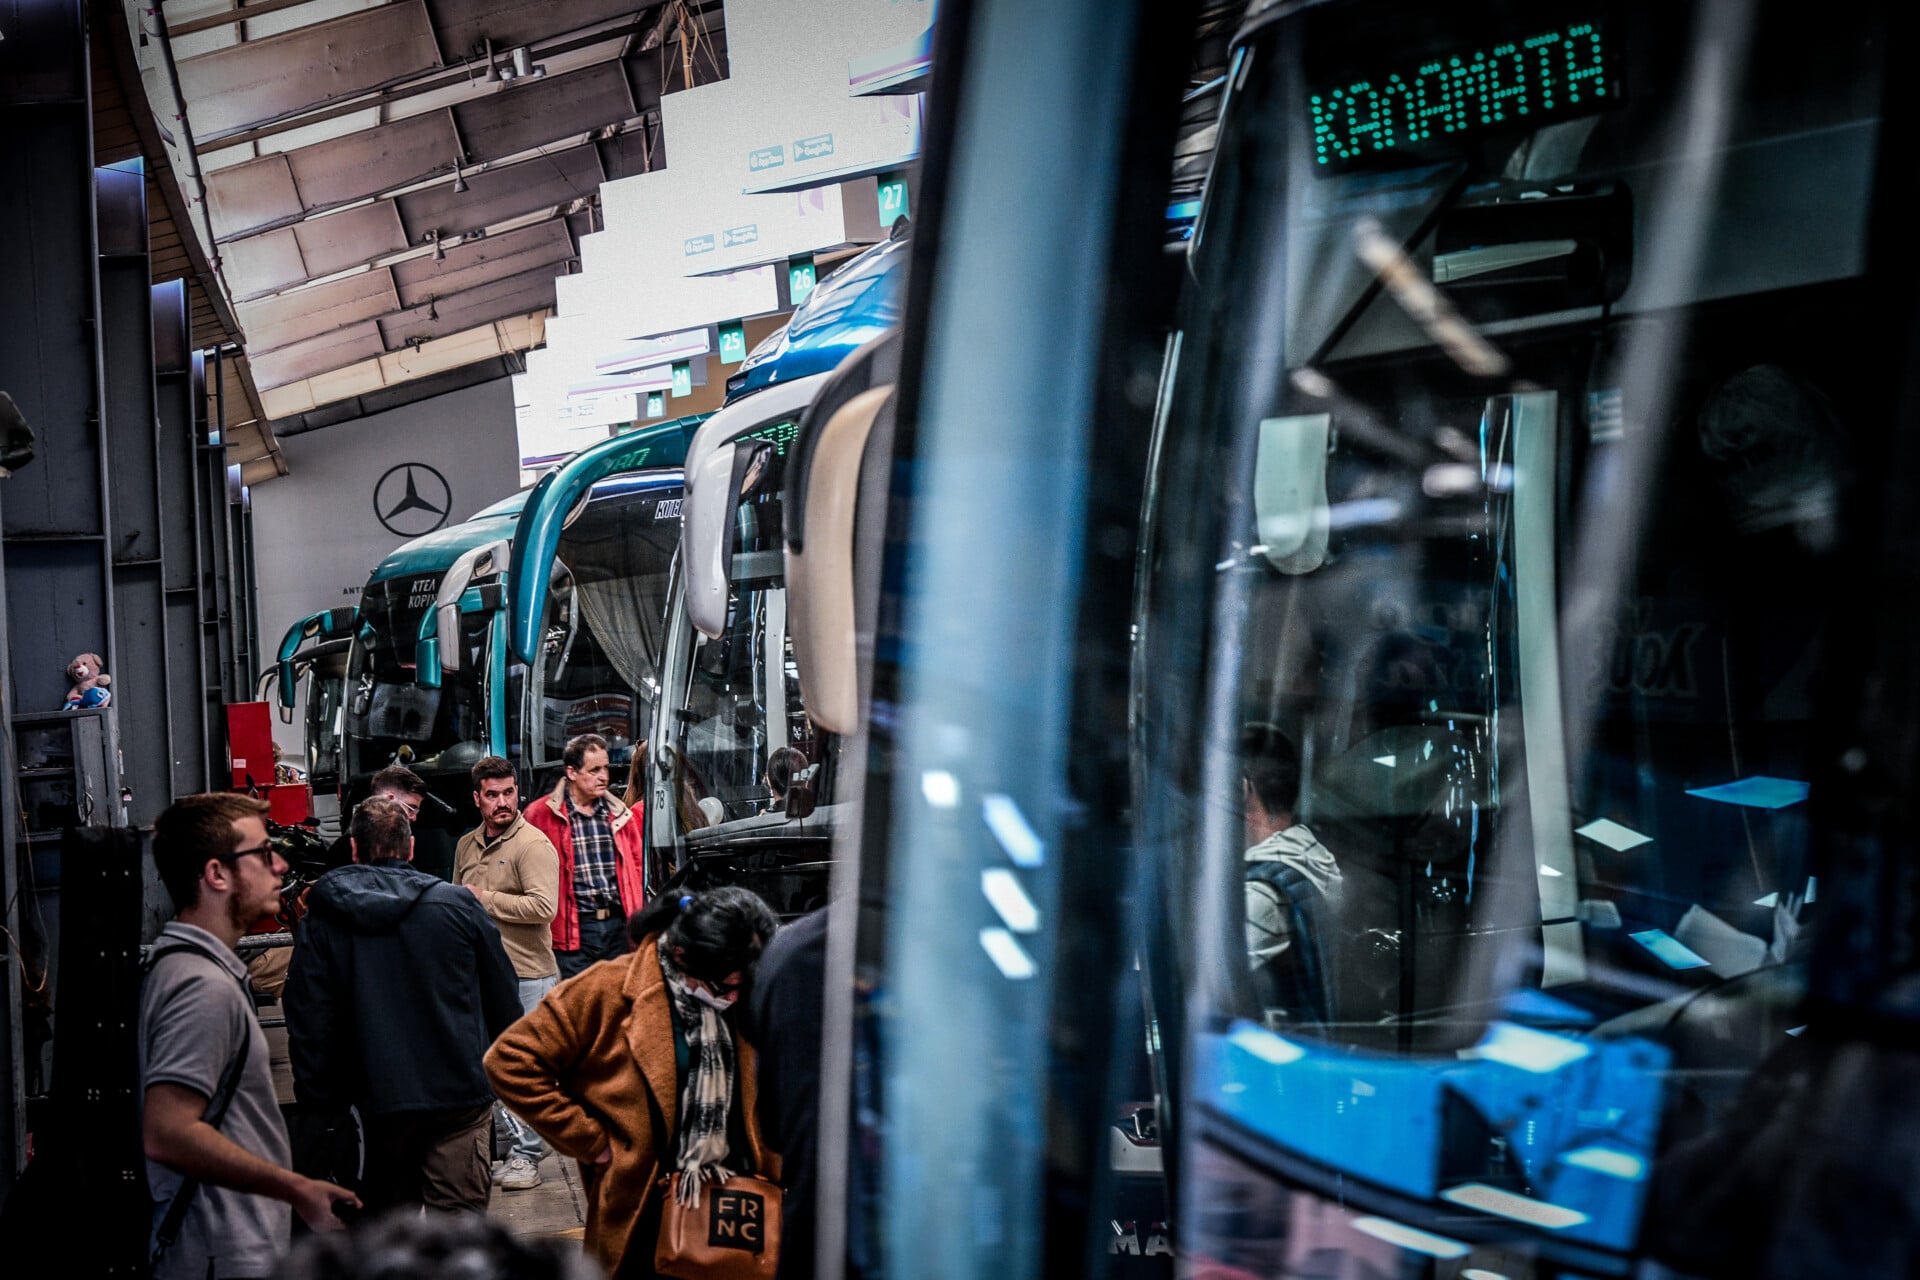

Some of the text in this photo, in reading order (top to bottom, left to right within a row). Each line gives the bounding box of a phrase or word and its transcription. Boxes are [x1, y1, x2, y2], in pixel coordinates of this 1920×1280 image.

[1311, 24, 1606, 164] ΚΑΛΑΜΑΤΑ
[883, 183, 903, 211] 27
[793, 268, 811, 291] 26
[723, 332, 741, 352] 25
[674, 369, 688, 386] 24
[655, 790, 665, 810] 78
